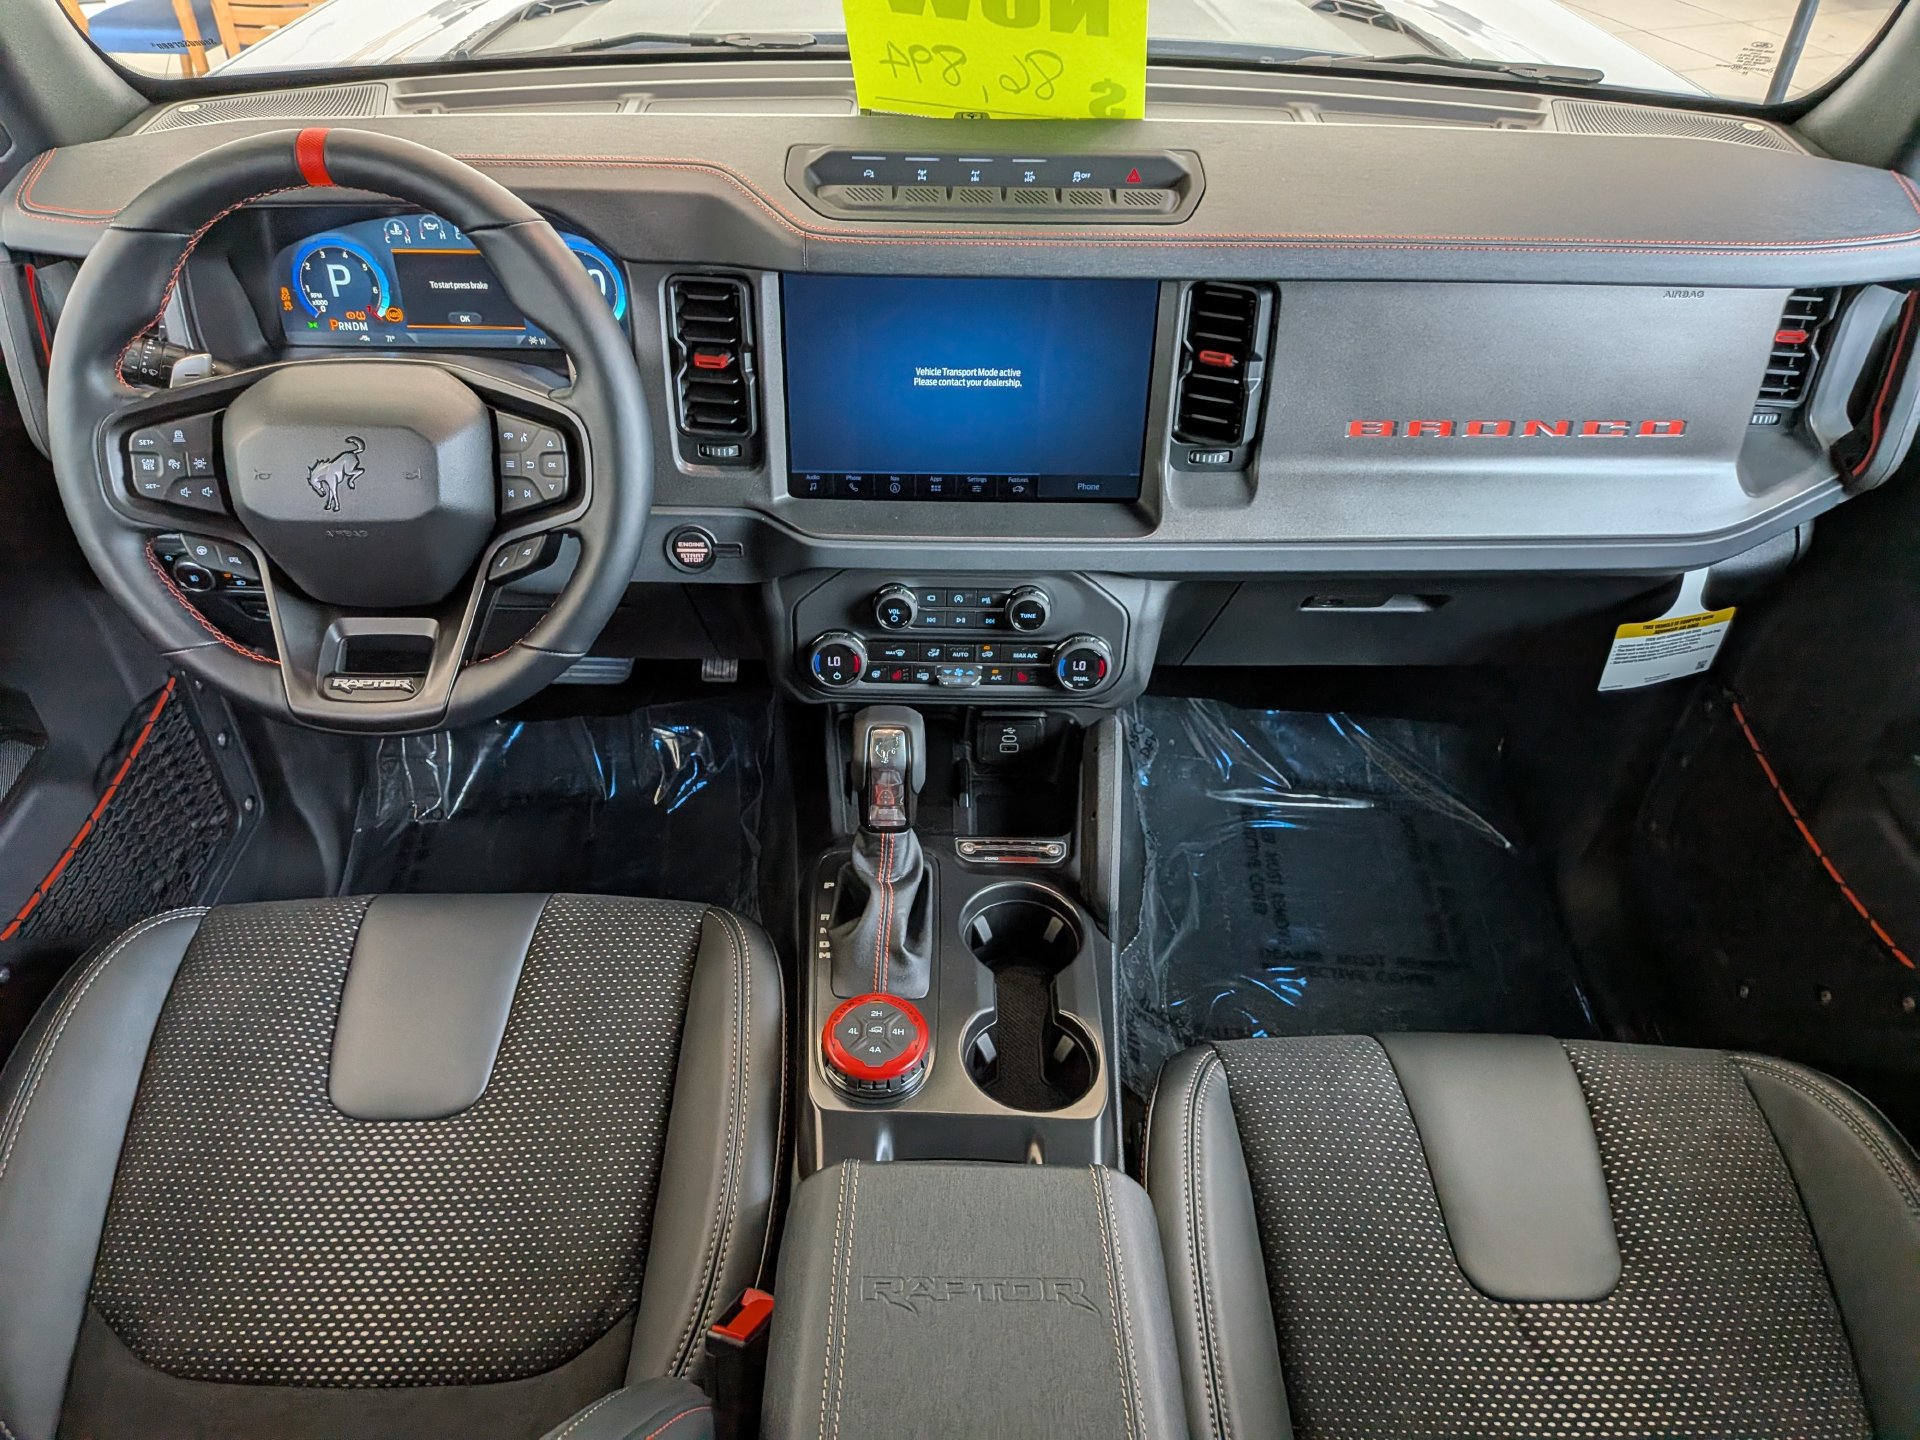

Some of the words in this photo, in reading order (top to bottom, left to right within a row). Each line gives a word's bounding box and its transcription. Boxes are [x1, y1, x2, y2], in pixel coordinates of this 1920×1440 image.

[384, 236, 391, 244] C
[404, 236, 411, 244] H
[440, 232, 447, 240] H
[320, 251, 326, 259] 3
[342, 251, 349, 259] 4
[305, 262, 311, 270] 2
[326, 264, 351, 297] P
[305, 285, 310, 293] 1
[438, 281, 453, 289] start
[454, 282, 470, 290] press
[470, 281, 488, 290] brake
[538, 337, 546, 345] W
[915, 367, 941, 376] Vehicle
[942, 367, 977, 377] Transport
[978, 367, 998, 377] Mode
[999, 368, 1021, 377] active
[914, 377, 937, 386] Please
[938, 378, 966, 386] contact
[966, 379, 982, 387] your
[983, 378, 1022, 388] dealership.
[1345, 420, 1687, 437] BRONCO
[1077, 483, 1100, 491] Phone
[828, 656, 840, 667] LO
[1073, 661, 1086, 671] LO
[332, 678, 415, 694] RAPTOR
[861, 1276, 1102, 1317] RAPTOR
